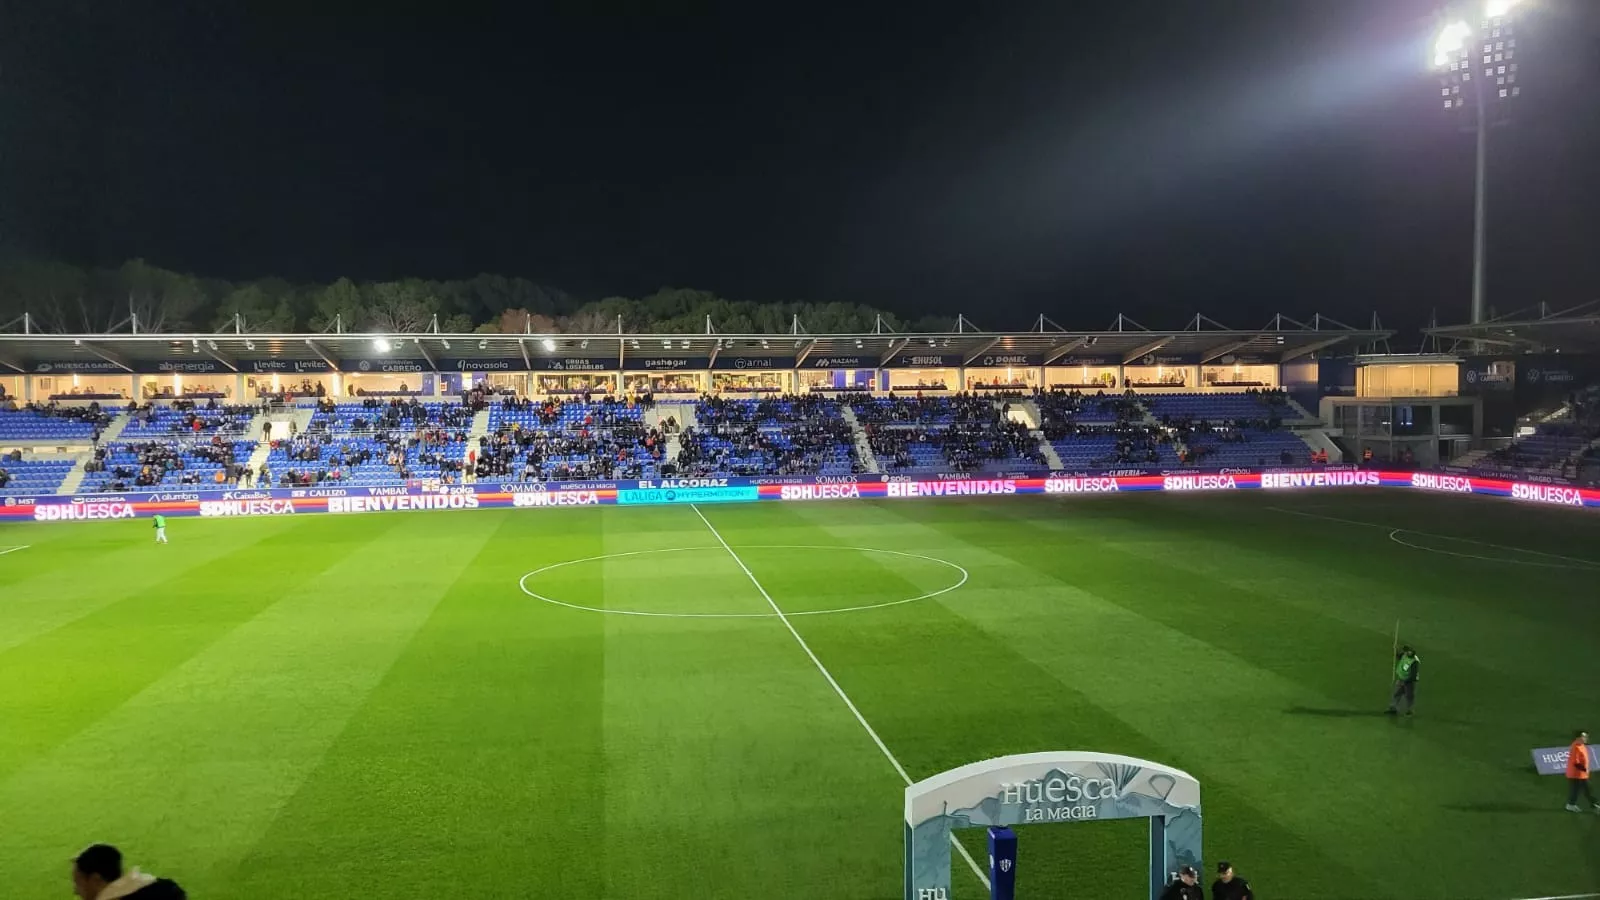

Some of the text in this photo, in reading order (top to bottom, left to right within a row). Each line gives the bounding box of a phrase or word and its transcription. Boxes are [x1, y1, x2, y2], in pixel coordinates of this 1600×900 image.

[645, 359, 687, 367] gashogar
[747, 358, 772, 366] arnal
[661, 479, 728, 488] ALCORAZ
[816, 476, 857, 484] SOMMOS
[1044, 478, 1119, 492] SDHUESCA
[1164, 475, 1236, 490] SDHUESCA
[1261, 472, 1380, 488] BIENVENIDOS
[1412, 473, 1472, 492] SDHUESCA
[500, 484, 546, 493] SOMMOS
[781, 484, 860, 499] SDHUESCA
[886, 480, 1016, 496] BIENVENIDOS
[1512, 483, 1583, 505] SDHUESCA
[328, 493, 480, 512] BIENVENIDOS
[513, 491, 598, 506] SDHUESCA
[34, 504, 135, 520] SDHUESCA
[200, 500, 295, 516] SDHUESCA
